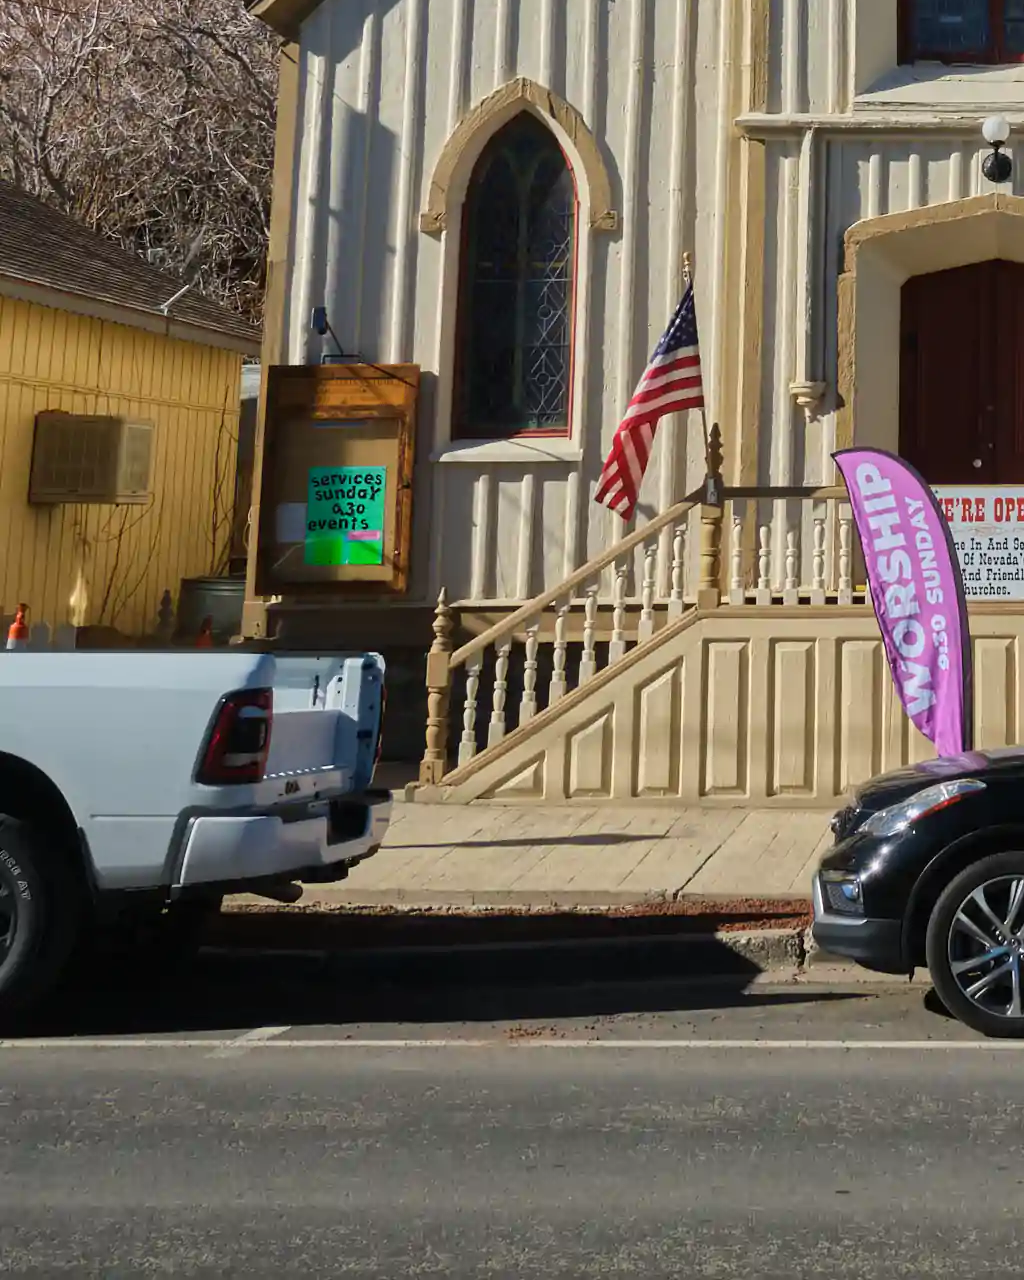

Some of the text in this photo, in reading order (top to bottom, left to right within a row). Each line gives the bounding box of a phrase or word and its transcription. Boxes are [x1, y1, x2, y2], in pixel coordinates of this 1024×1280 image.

[311, 473, 382, 488] services
[938, 497, 985, 523] E'RE
[308, 517, 369, 532] events
[905, 496, 943, 605] SUNDAY
[970, 537, 983, 551] In
[987, 537, 1009, 551] And
[963, 552, 975, 566] Of
[856, 461, 937, 716] WORSHIP
[963, 582, 1012, 596] hurches.
